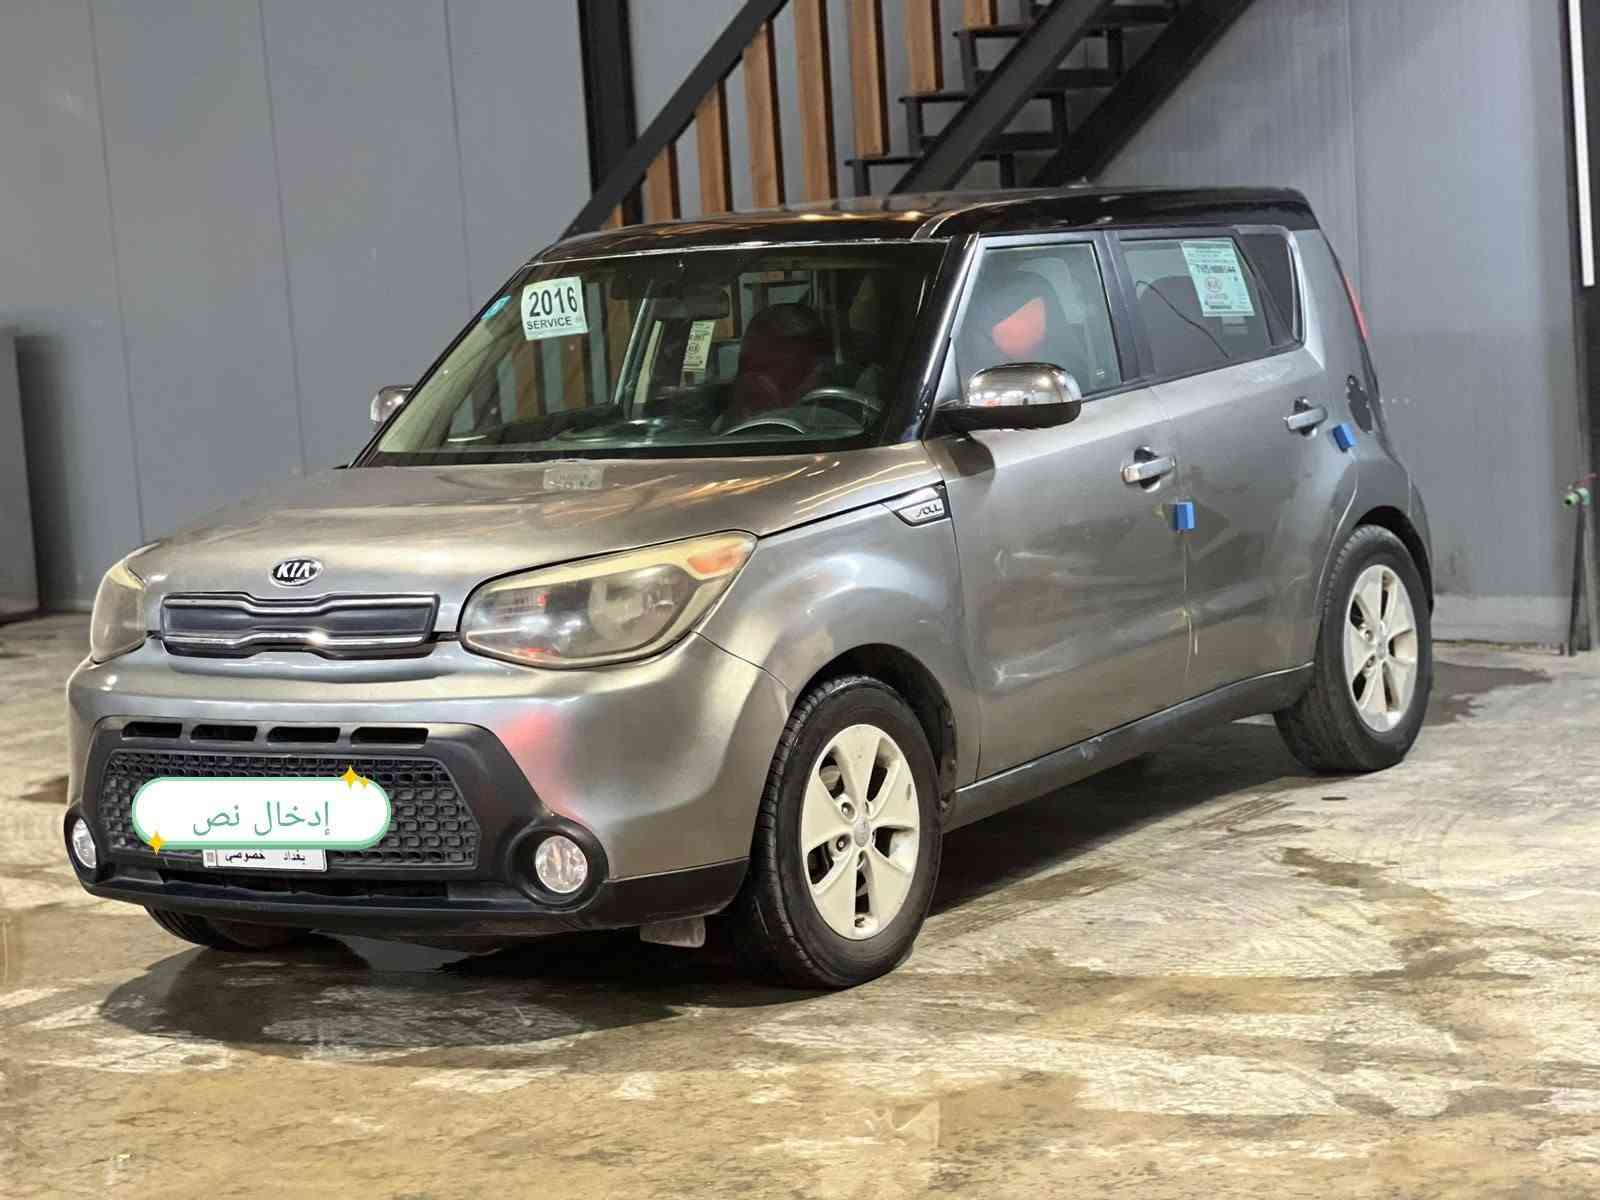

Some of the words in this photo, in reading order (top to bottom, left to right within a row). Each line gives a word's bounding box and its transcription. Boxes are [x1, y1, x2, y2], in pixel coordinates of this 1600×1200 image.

[528, 286, 578, 317] 2016
[526, 316, 574, 330] SERVICE
[276, 562, 312, 578] KIA
